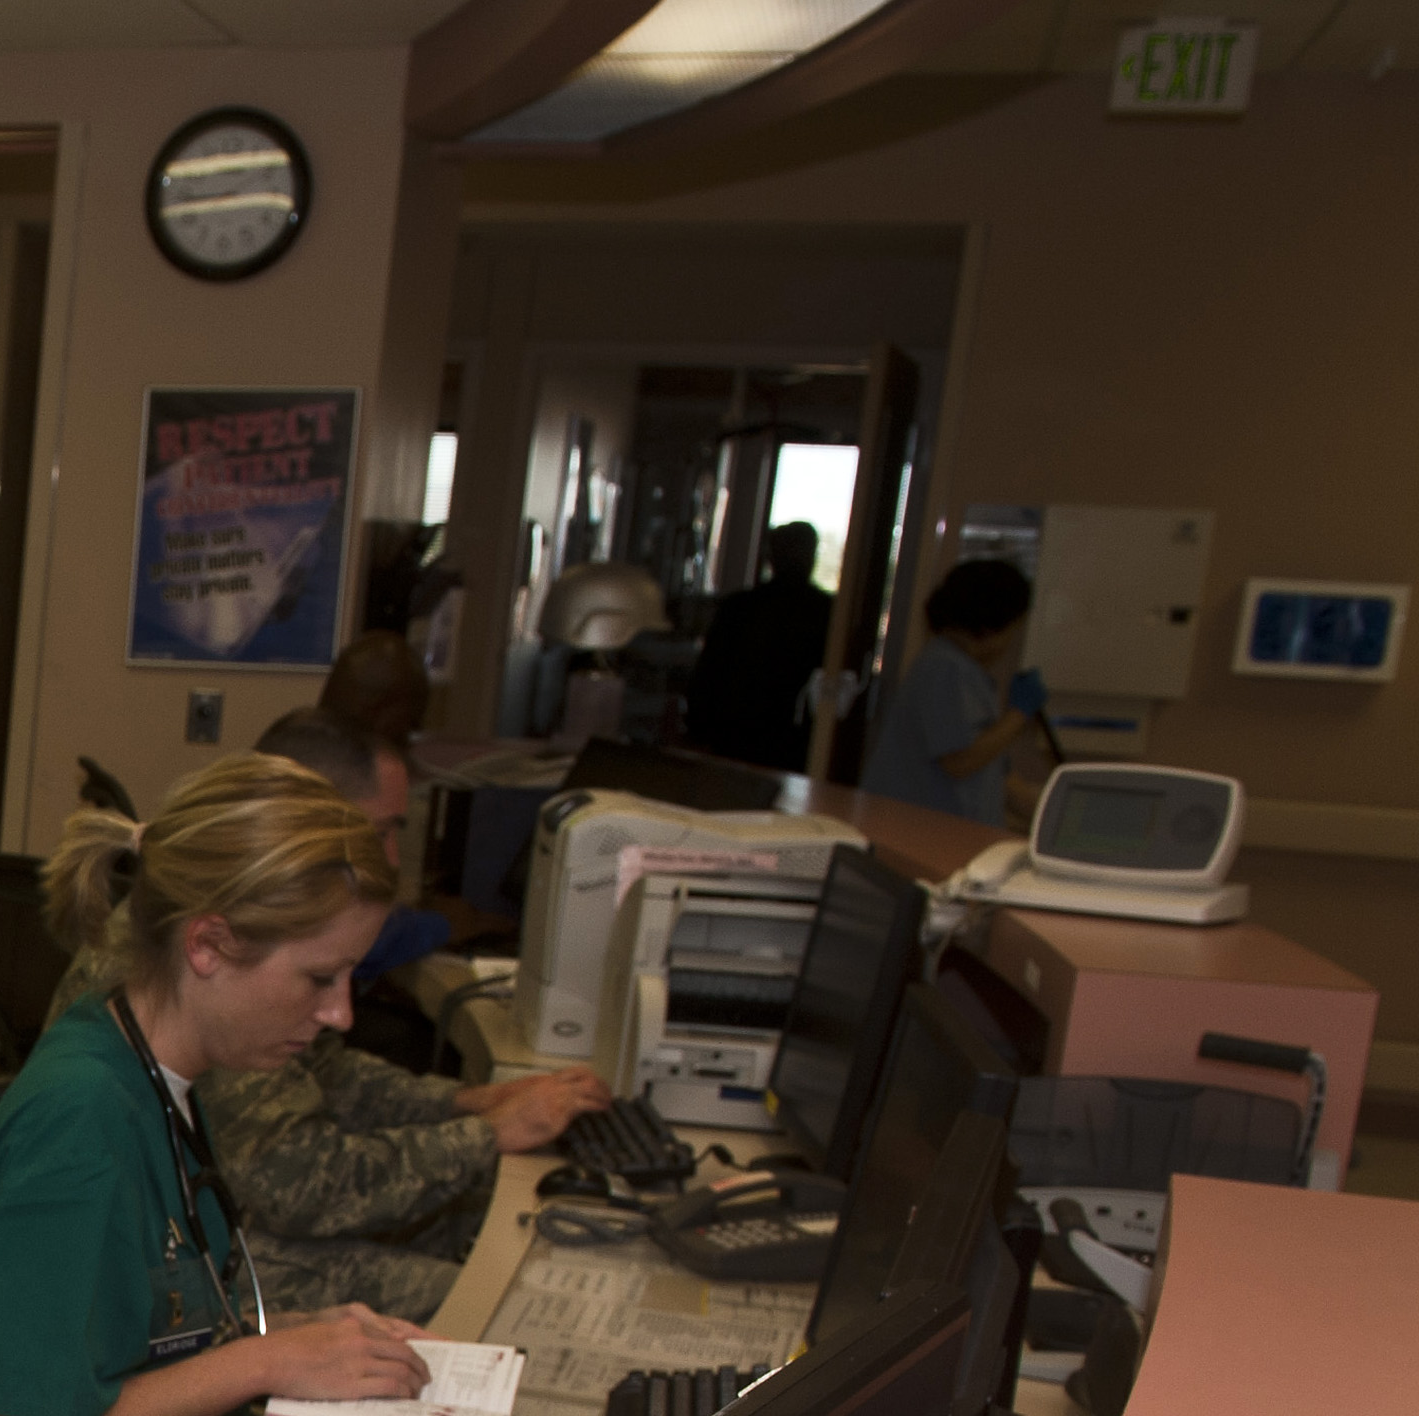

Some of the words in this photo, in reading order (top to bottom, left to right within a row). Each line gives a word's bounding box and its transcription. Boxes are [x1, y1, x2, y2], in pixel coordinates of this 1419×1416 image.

[1139, 33, 1240, 102] EXIT
[156, 400, 338, 460] RESPECT
[205, 549, 265, 574] matters
